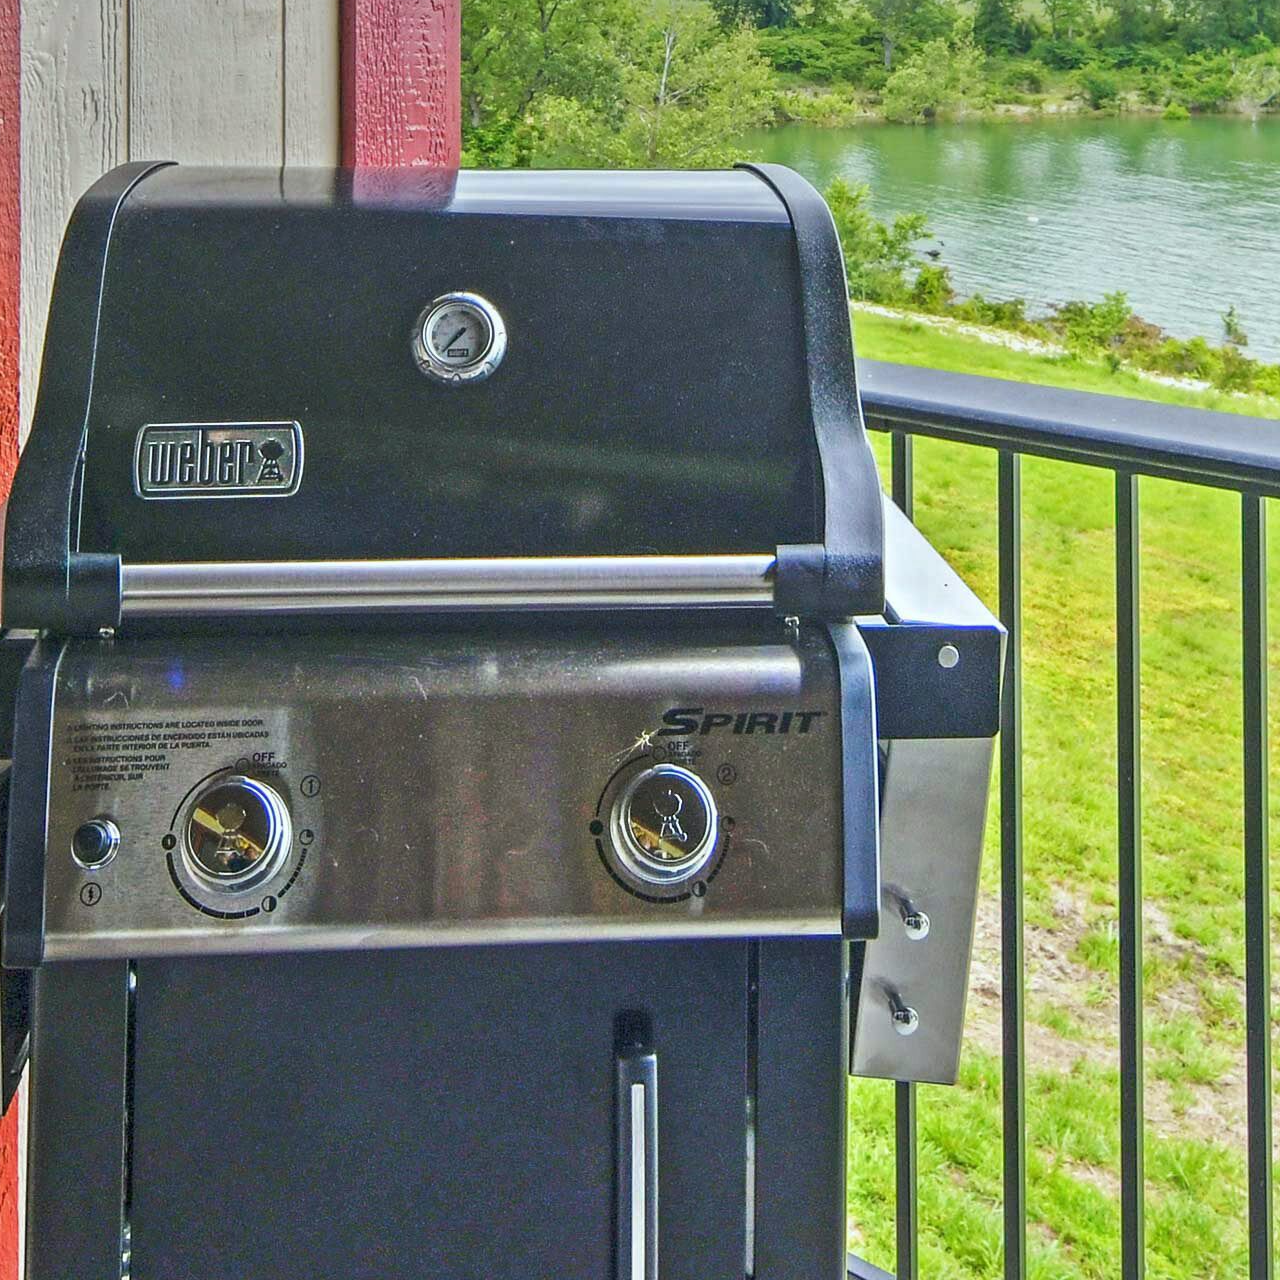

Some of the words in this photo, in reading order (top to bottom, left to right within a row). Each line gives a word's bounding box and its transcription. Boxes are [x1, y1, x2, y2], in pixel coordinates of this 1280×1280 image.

[148, 428, 255, 484] weber
[110, 722, 163, 730] INSTRUCTIONS
[164, 721, 180, 729] ARE
[181, 720, 215, 729] LOCATED
[216, 719, 240, 728] INSIDE
[657, 707, 823, 736] SPIRIT
[162, 732, 207, 741] ENCENDIDO
[158, 742, 169, 750] DE
[169, 741, 180, 749] LA
[667, 741, 689, 751] OFF
[144, 754, 166, 762] POUR
[252, 752, 275, 762] OFF
[131, 763, 170, 771] TROUVENT
[127, 773, 144, 781] SUR
